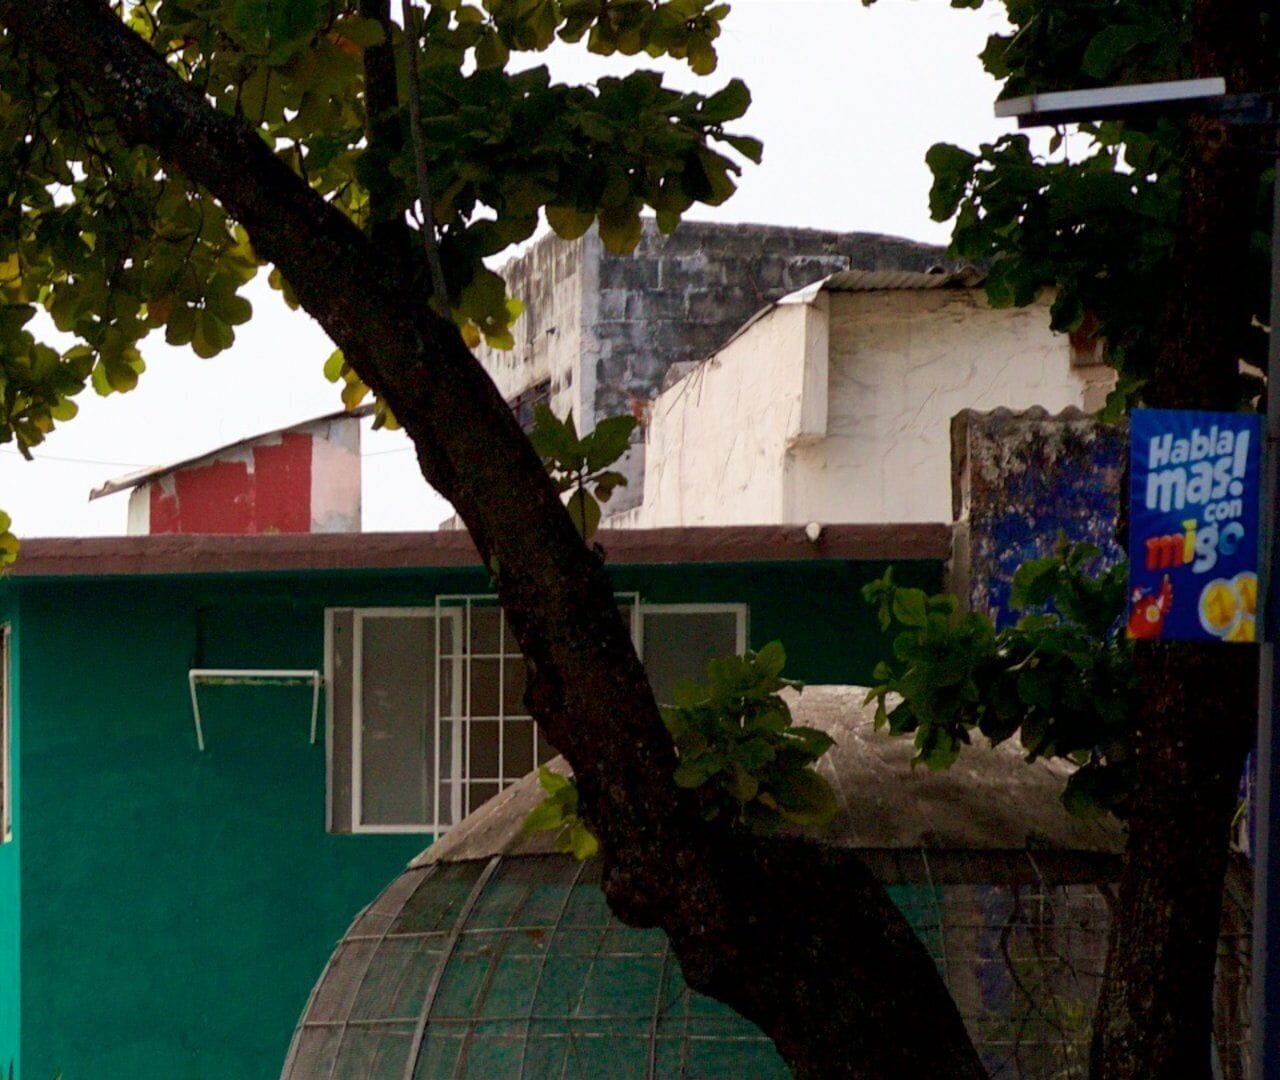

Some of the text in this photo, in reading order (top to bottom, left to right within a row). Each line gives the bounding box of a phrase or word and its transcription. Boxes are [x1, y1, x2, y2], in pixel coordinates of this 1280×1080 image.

[1146, 430, 1250, 512] mas!
[1149, 426, 1234, 468] Habla
[1204, 500, 1242, 522] con
[1146, 519, 1244, 573] migo
